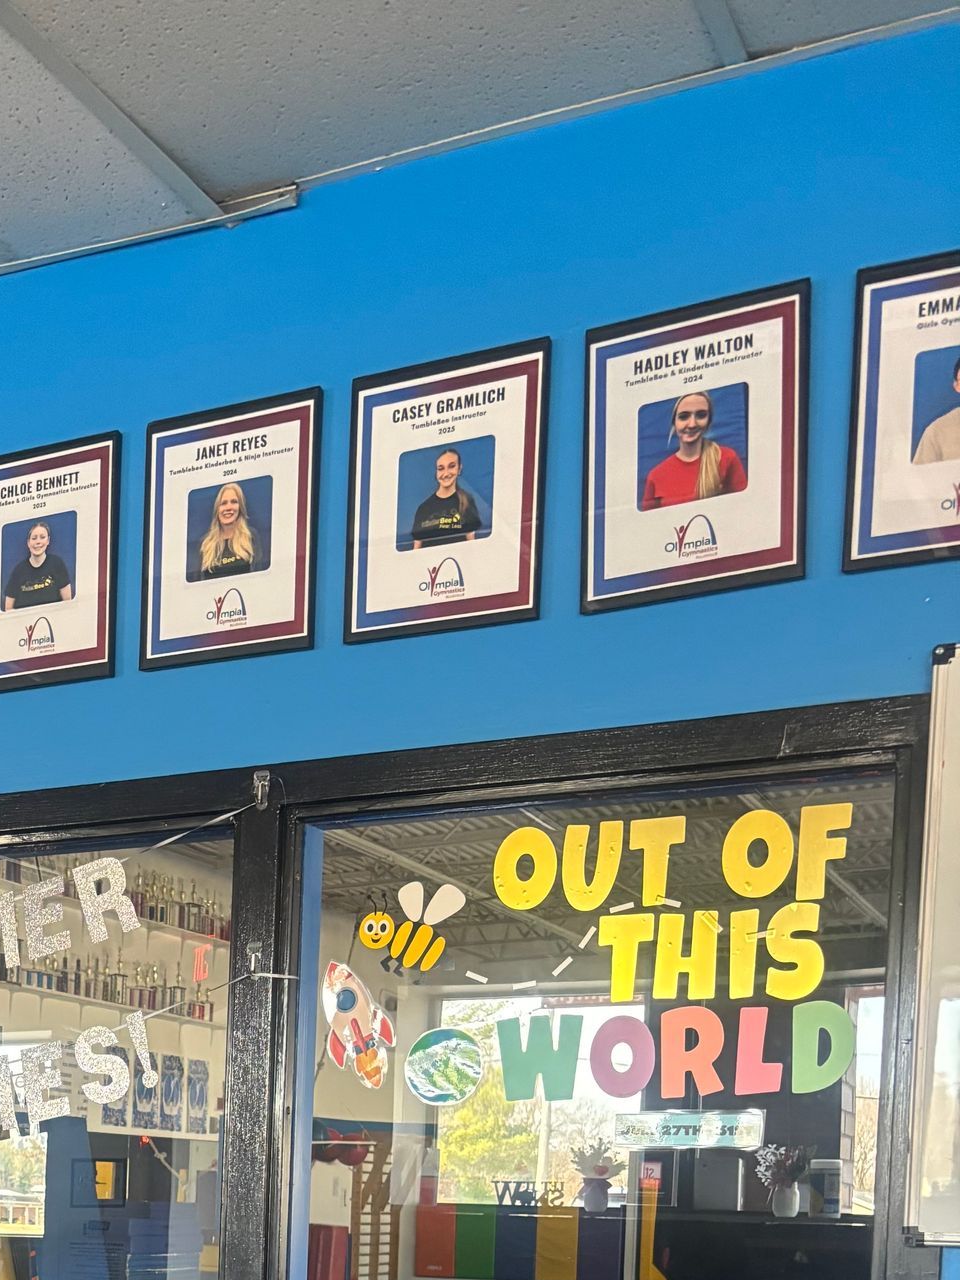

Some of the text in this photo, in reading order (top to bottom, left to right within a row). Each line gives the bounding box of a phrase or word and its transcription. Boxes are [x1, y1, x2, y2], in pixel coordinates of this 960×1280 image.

[634, 333, 754, 376] HADLEY WALTON
[670, 369, 676, 377] &
[722, 350, 763, 364] Instructor
[683, 373, 703, 384] 2024
[392, 386, 506, 424] CASEY GRAMLICH
[451, 410, 487, 422] Instructor
[196, 434, 268, 461] JANET REYES
[244, 454, 261, 462] Ninja
[262, 446, 294, 457] Instructor
[0, 471, 80, 499] CHLOE BENNETT
[36, 489, 69, 500] Gymnastics
[70, 482, 98, 492] Instructor
[493, 802, 854, 912] OUT OF
[598, 902, 826, 1002] THIS
[496, 1000, 855, 1102] WORLD
[661, 1124, 704, 1136] 27TH
